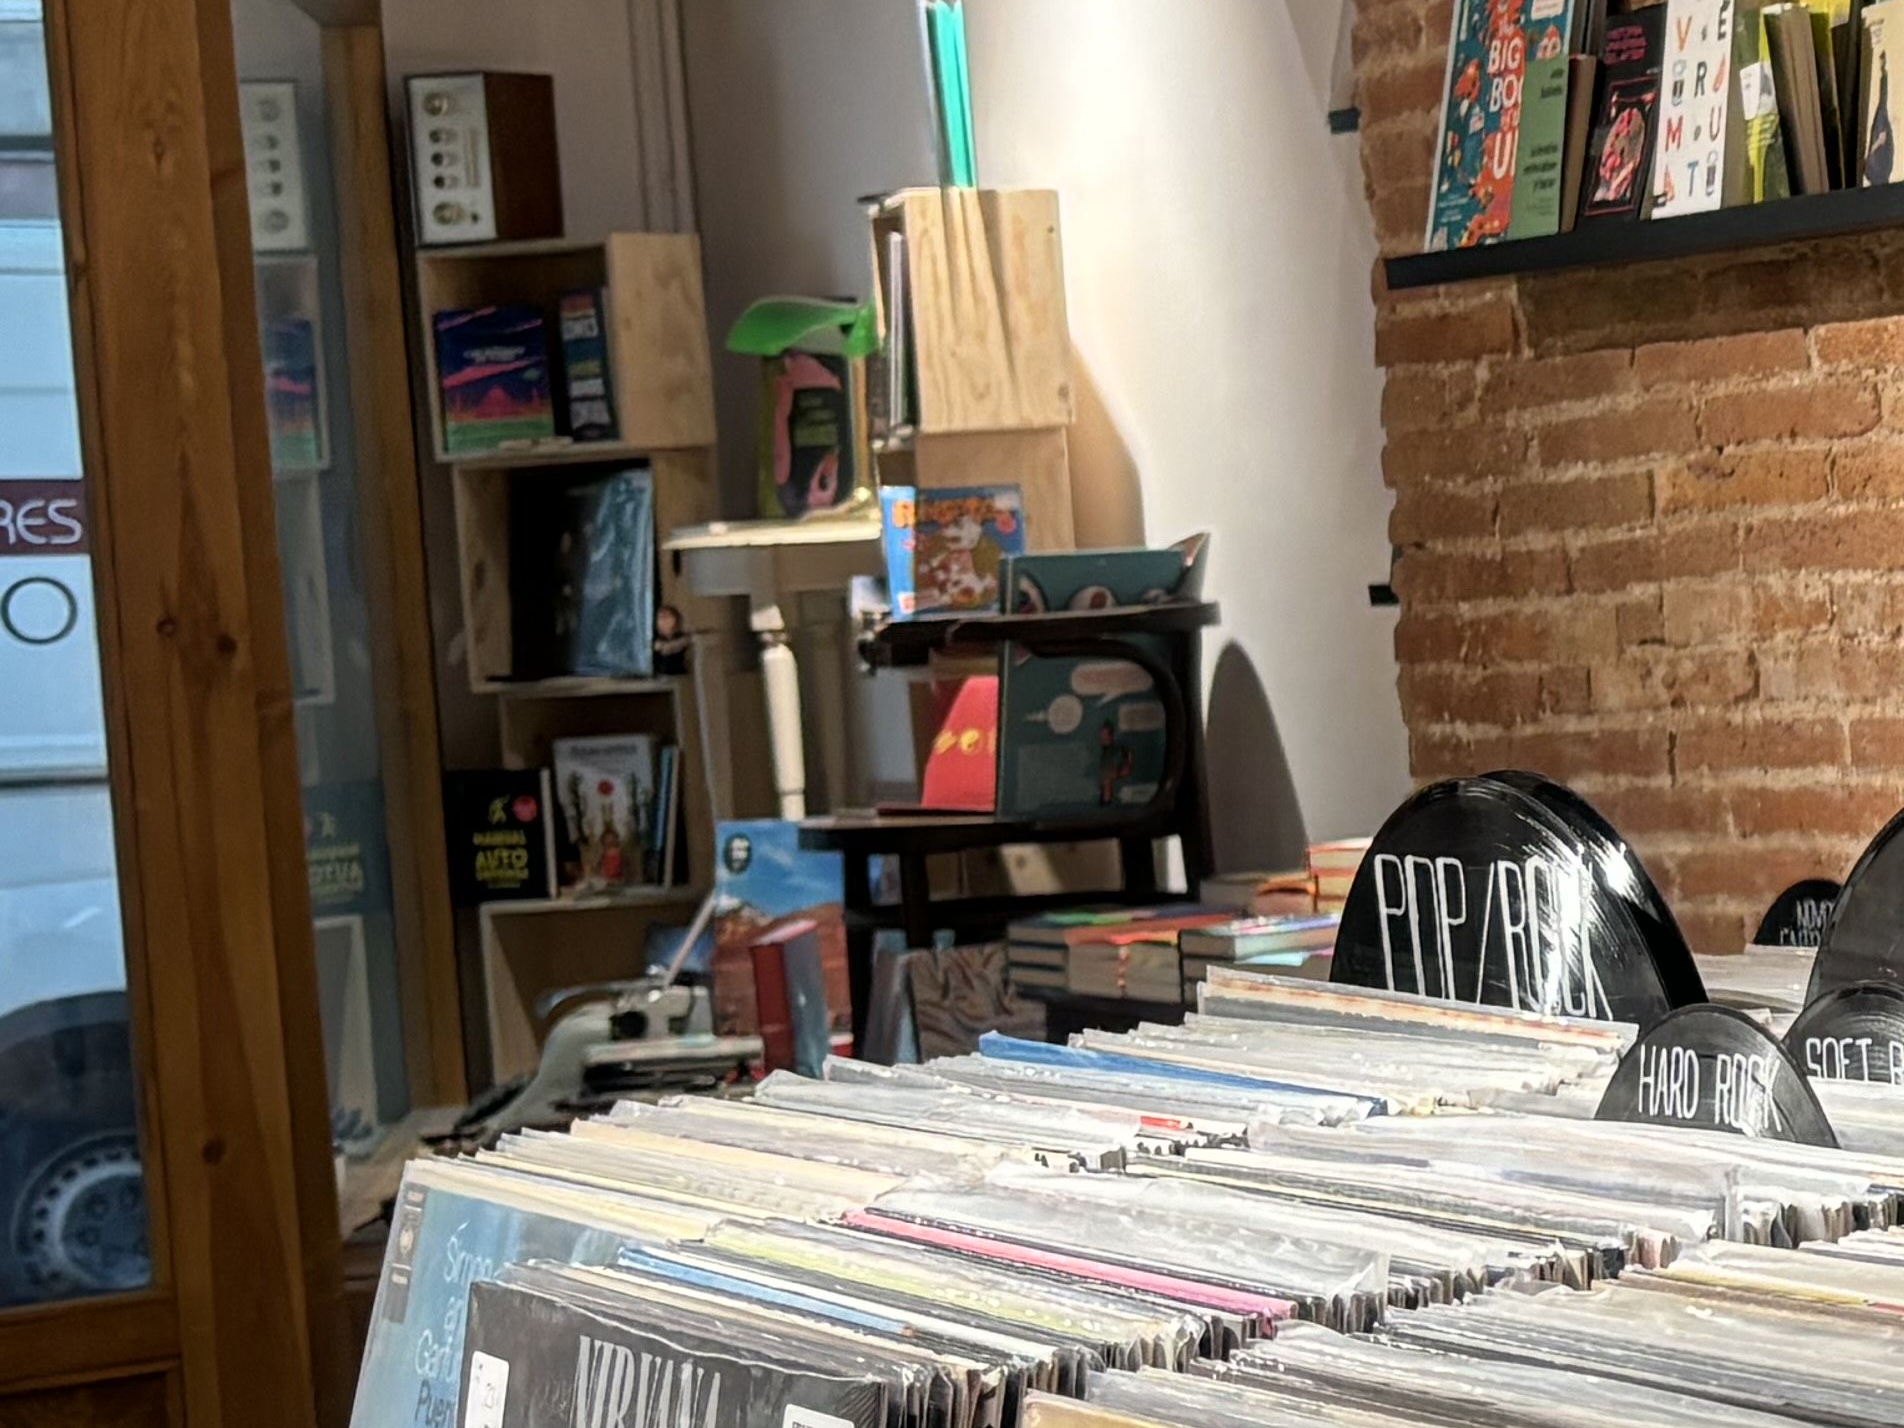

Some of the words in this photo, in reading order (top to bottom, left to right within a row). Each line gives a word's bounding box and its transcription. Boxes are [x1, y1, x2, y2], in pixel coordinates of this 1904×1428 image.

[1488, 39, 1522, 75] BIG
[1805, 1036, 1873, 1082] SOFT
[1638, 1044, 1700, 1120] HARD
[1713, 1052, 1782, 1134] ROCK
